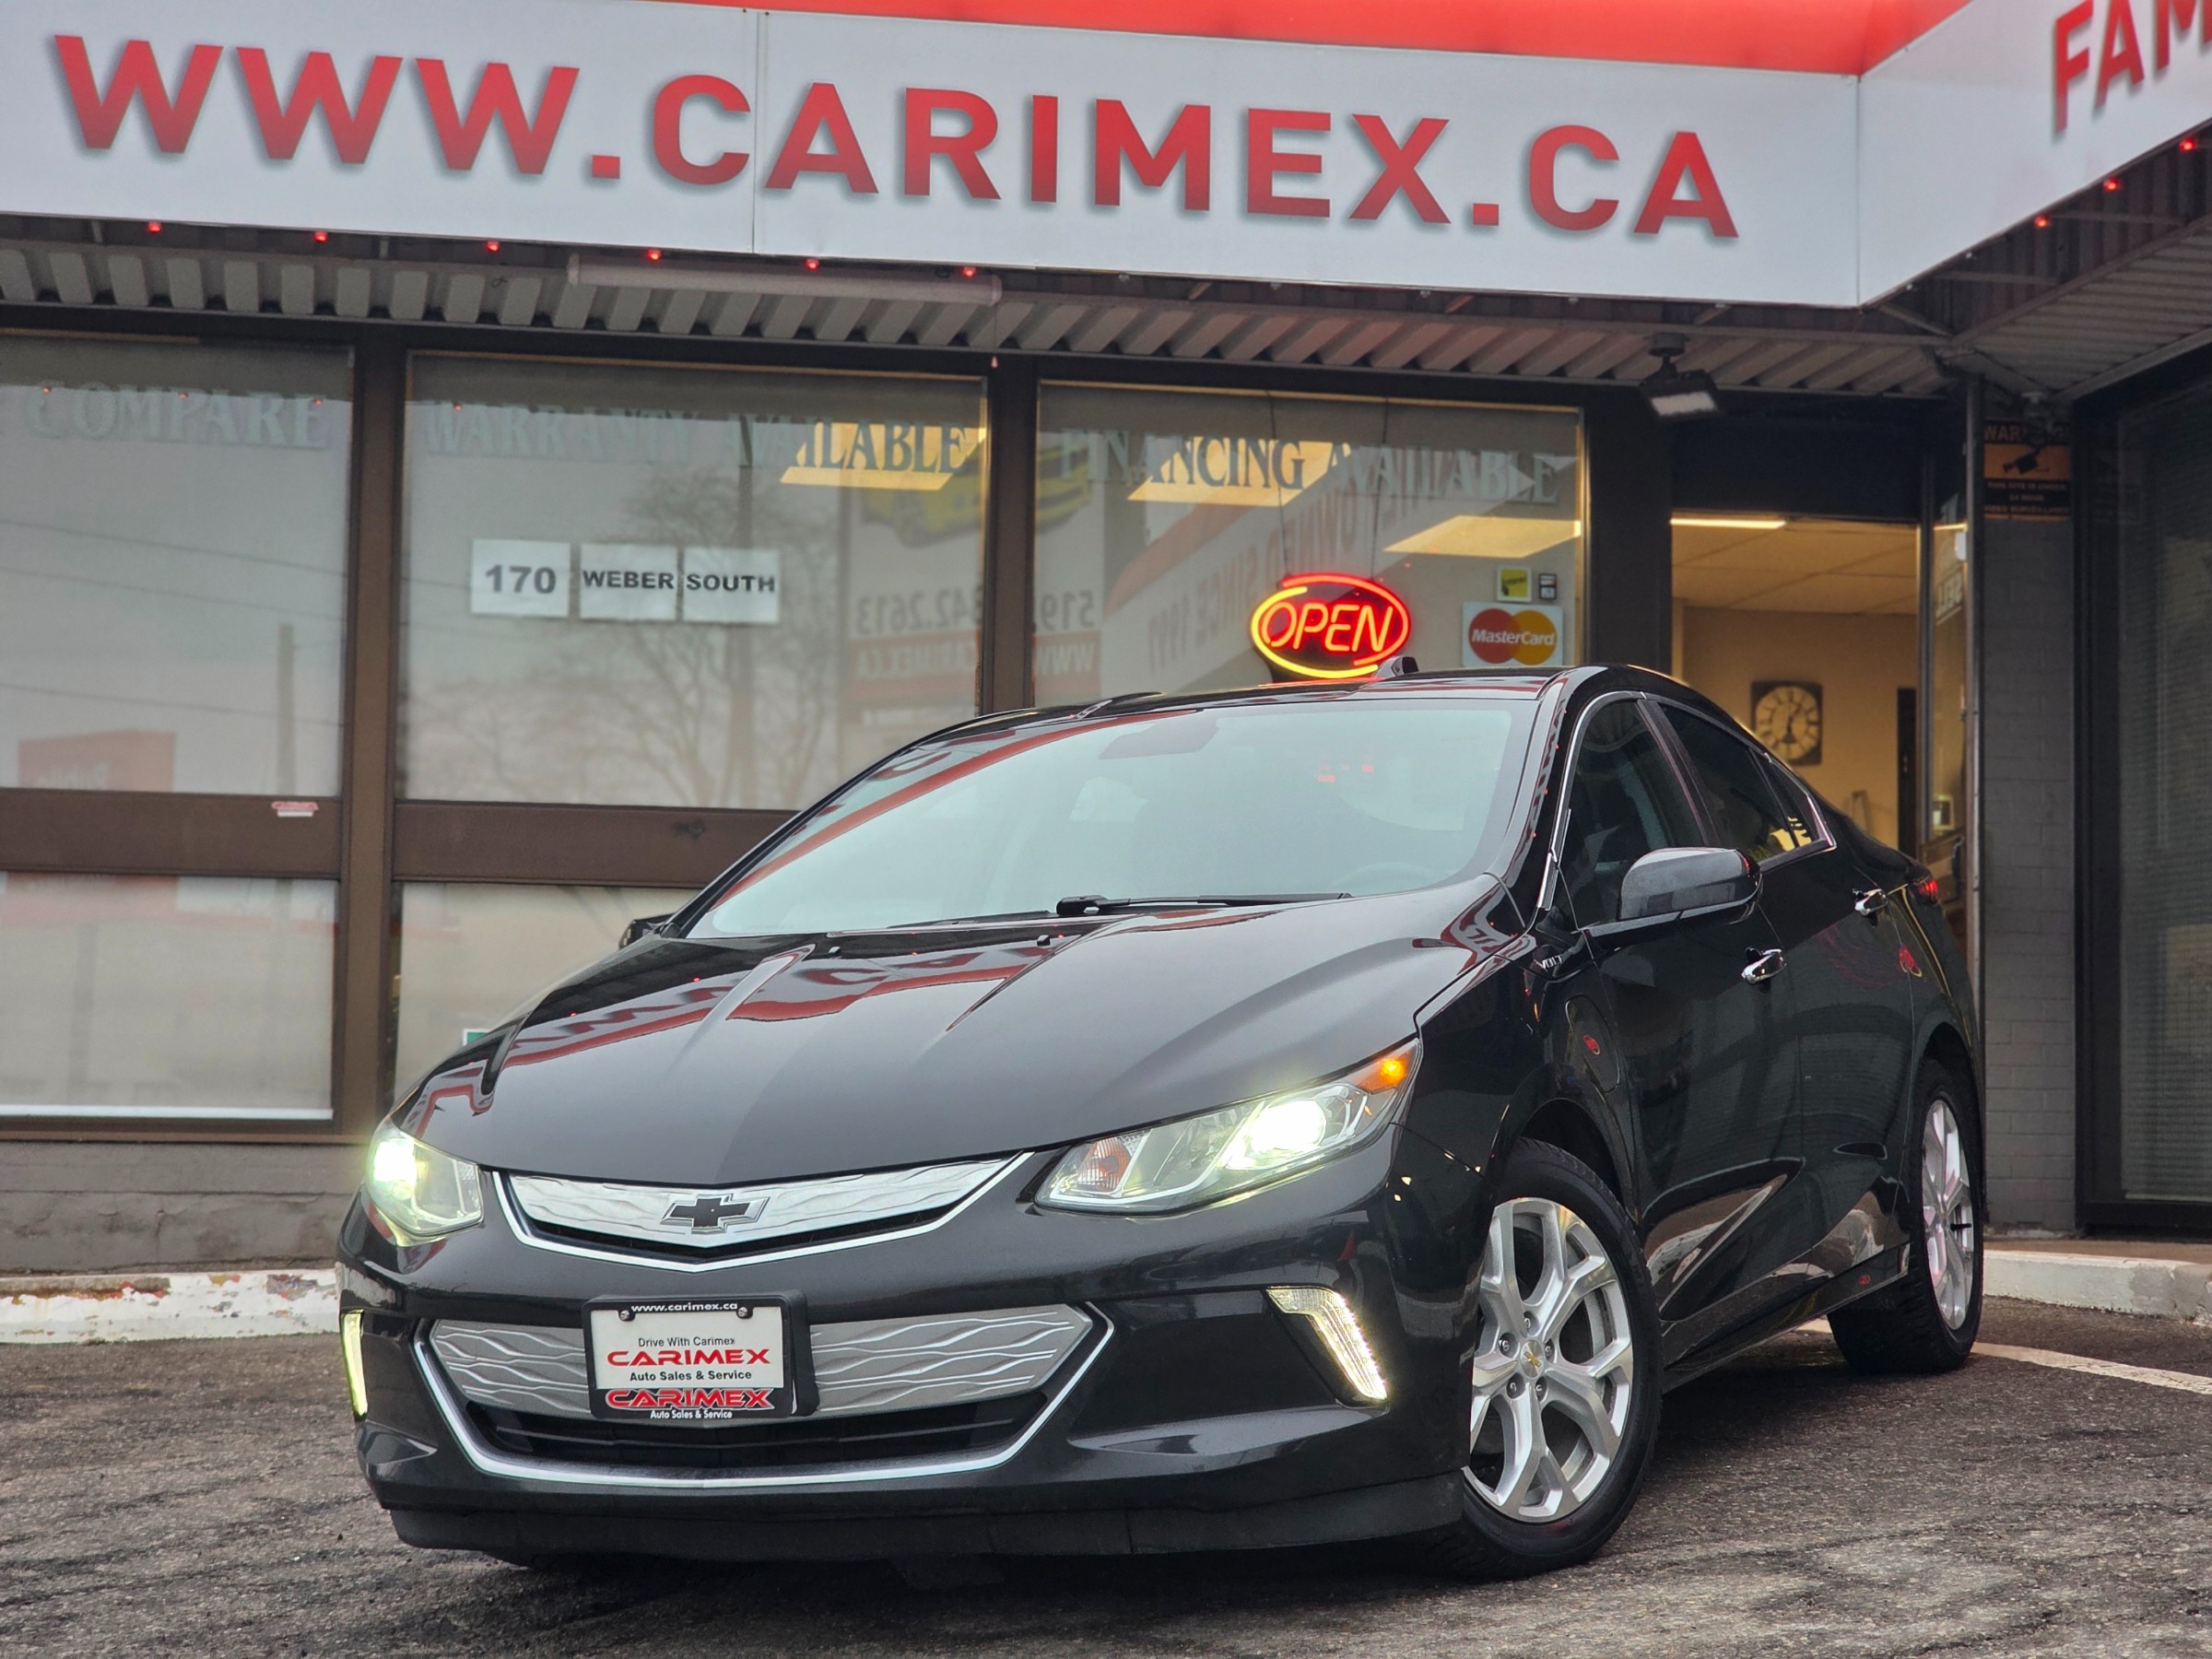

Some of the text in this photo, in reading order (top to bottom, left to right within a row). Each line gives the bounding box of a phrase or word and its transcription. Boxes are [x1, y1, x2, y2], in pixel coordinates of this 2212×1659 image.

[54, 34, 1739, 239] WWW.CARIMEX.CA
[25, 379, 330, 450] COMPARE
[1061, 427, 1559, 505] FINANCING AVAILABLE
[485, 564, 776, 594] 170 WEBER SOUTH
[1261, 602, 1394, 653] OPEN
[1472, 629, 1555, 645] MasterCard
[631, 1302, 737, 1312] www.carimex.ca
[638, 1336, 735, 1347] Drive With Carimex
[607, 1348, 771, 1366] CARIMEX
[629, 1370, 752, 1382] Auto Sales & Service
[606, 1388, 774, 1409] CARIMEX
[650, 1409, 733, 1419] Auto Sales & Service
